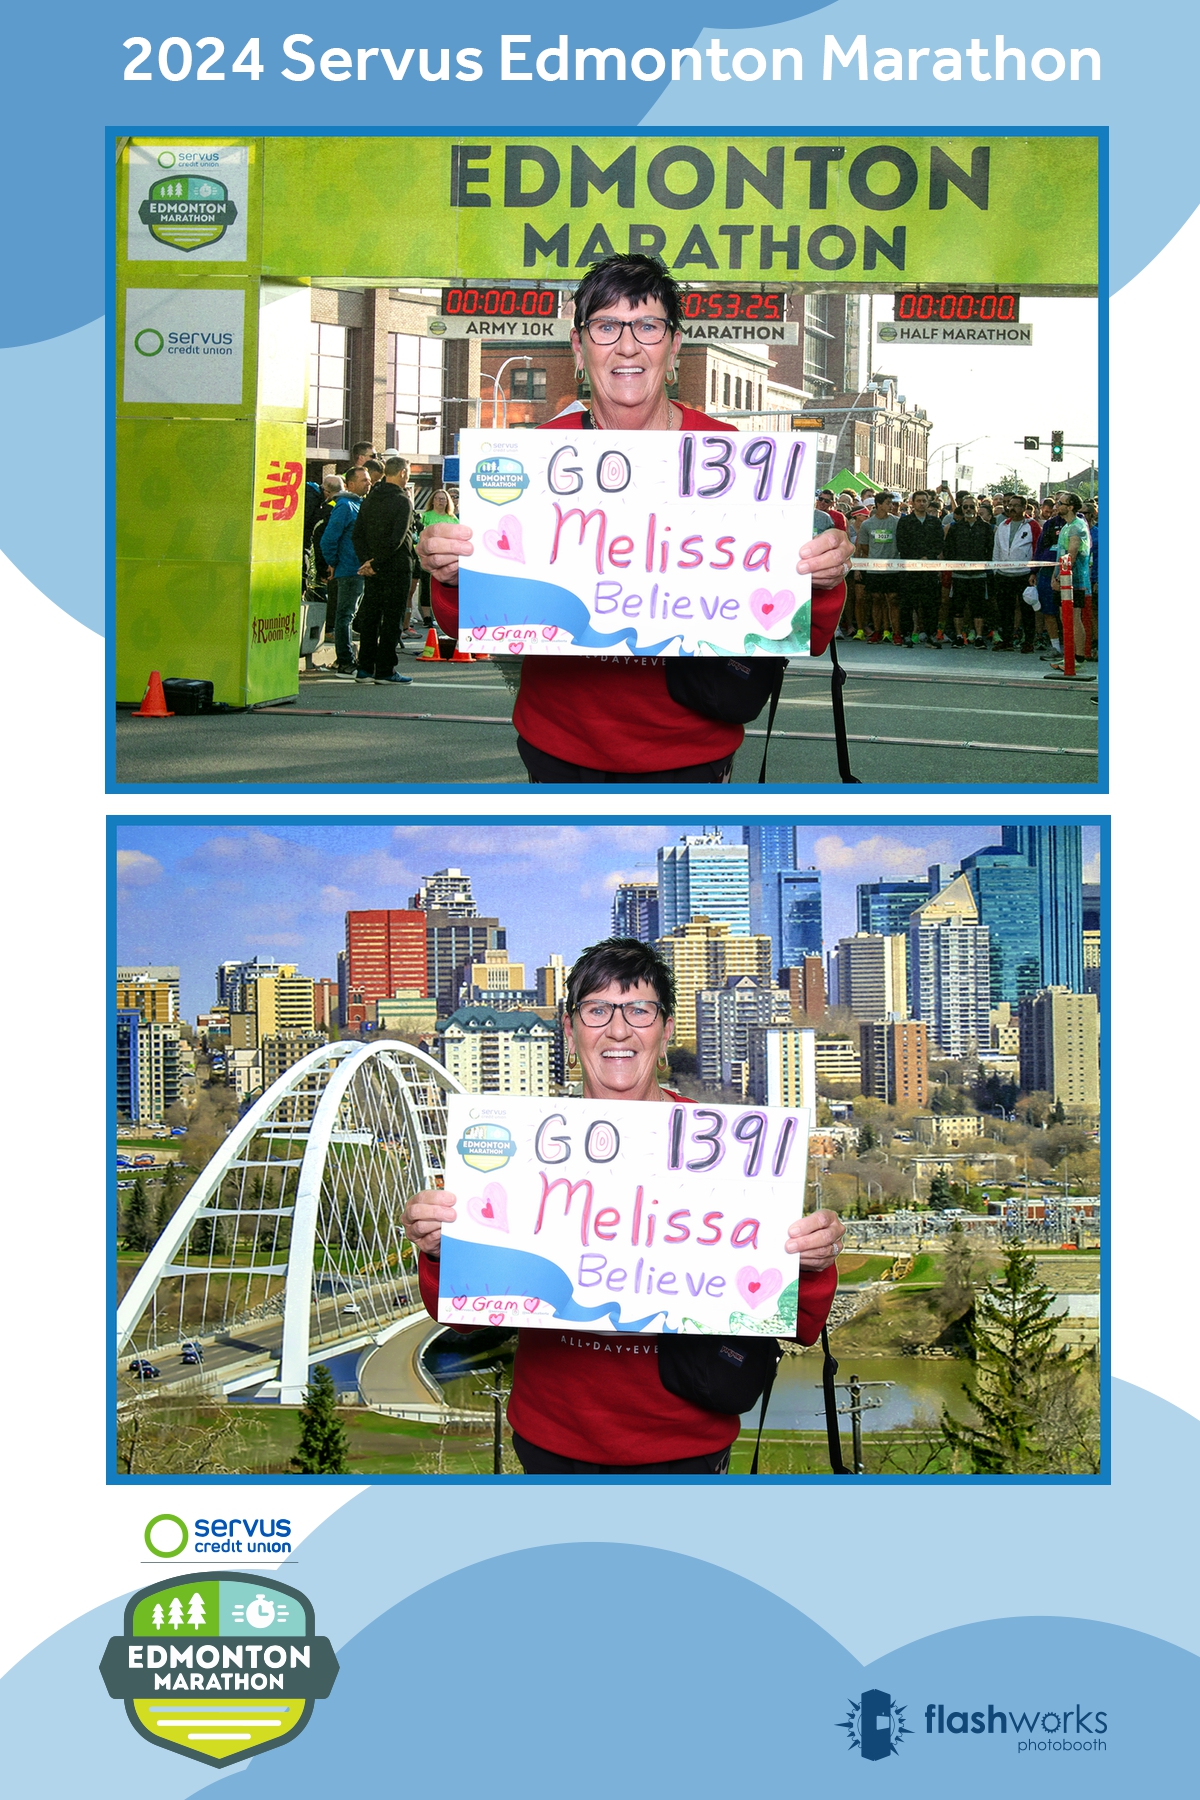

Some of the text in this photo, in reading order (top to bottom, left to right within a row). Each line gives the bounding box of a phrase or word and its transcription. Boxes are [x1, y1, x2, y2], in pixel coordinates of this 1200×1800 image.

[178, 152, 219, 161] servus
[449, 144, 990, 211] EDMONTON
[149, 202, 227, 214] EDMONTON
[160, 214, 215, 222] MARATHON
[523, 223, 907, 271] MARATHON
[465, 321, 555, 336] ARMY 10K
[680, 325, 785, 340] MARATHON
[900, 328, 1031, 341] HALF MARATHON
[168, 332, 233, 345] servus
[167, 345, 233, 355] credit union
[547, 432, 807, 502] GO 1391
[476, 474, 524, 483] EDMONTON
[549, 501, 772, 575] Melissa
[594, 580, 741, 621] Believe
[491, 626, 537, 641] Gram
[600, 655, 630, 665] DAY
[462, 1140, 511, 1149] EDMONTON
[534, 1103, 799, 1178] GO 1391
[533, 1170, 761, 1250] Melissa
[578, 1252, 727, 1298] Believe
[472, 1296, 518, 1312] Gram
[560, 1335, 583, 1348] ALL
[593, 1341, 623, 1354] DAY
